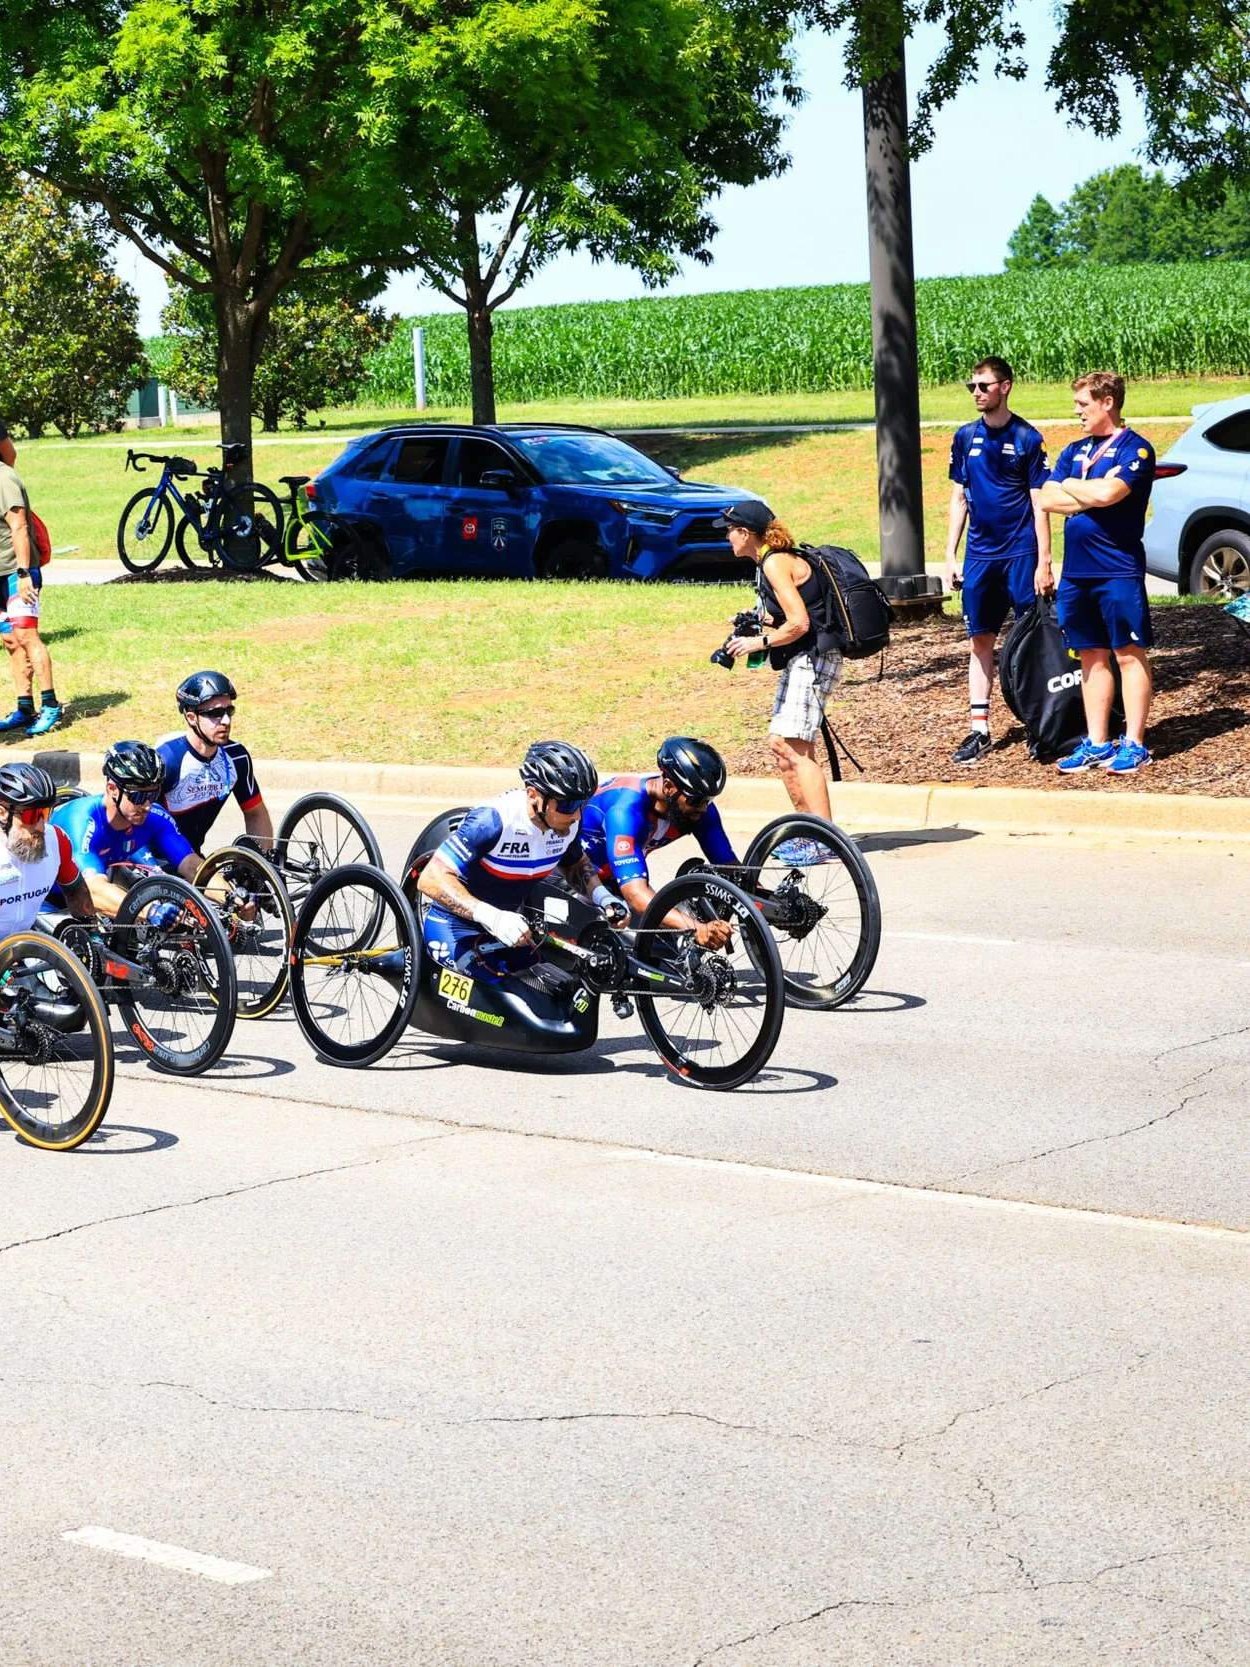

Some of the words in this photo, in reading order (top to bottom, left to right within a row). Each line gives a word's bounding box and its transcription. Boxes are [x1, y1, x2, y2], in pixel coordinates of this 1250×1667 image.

[1047, 669, 1083, 693] COR
[500, 842, 530, 854] FRA
[613, 857, 640, 867] TOYOTA
[0, 885, 51, 906] PORTUGAL
[704, 882, 734, 904] SWISS
[733, 902, 751, 919] DT
[403, 945, 413, 985] SWISS
[399, 986, 409, 1010] DT
[441, 973, 470, 1001] 276
